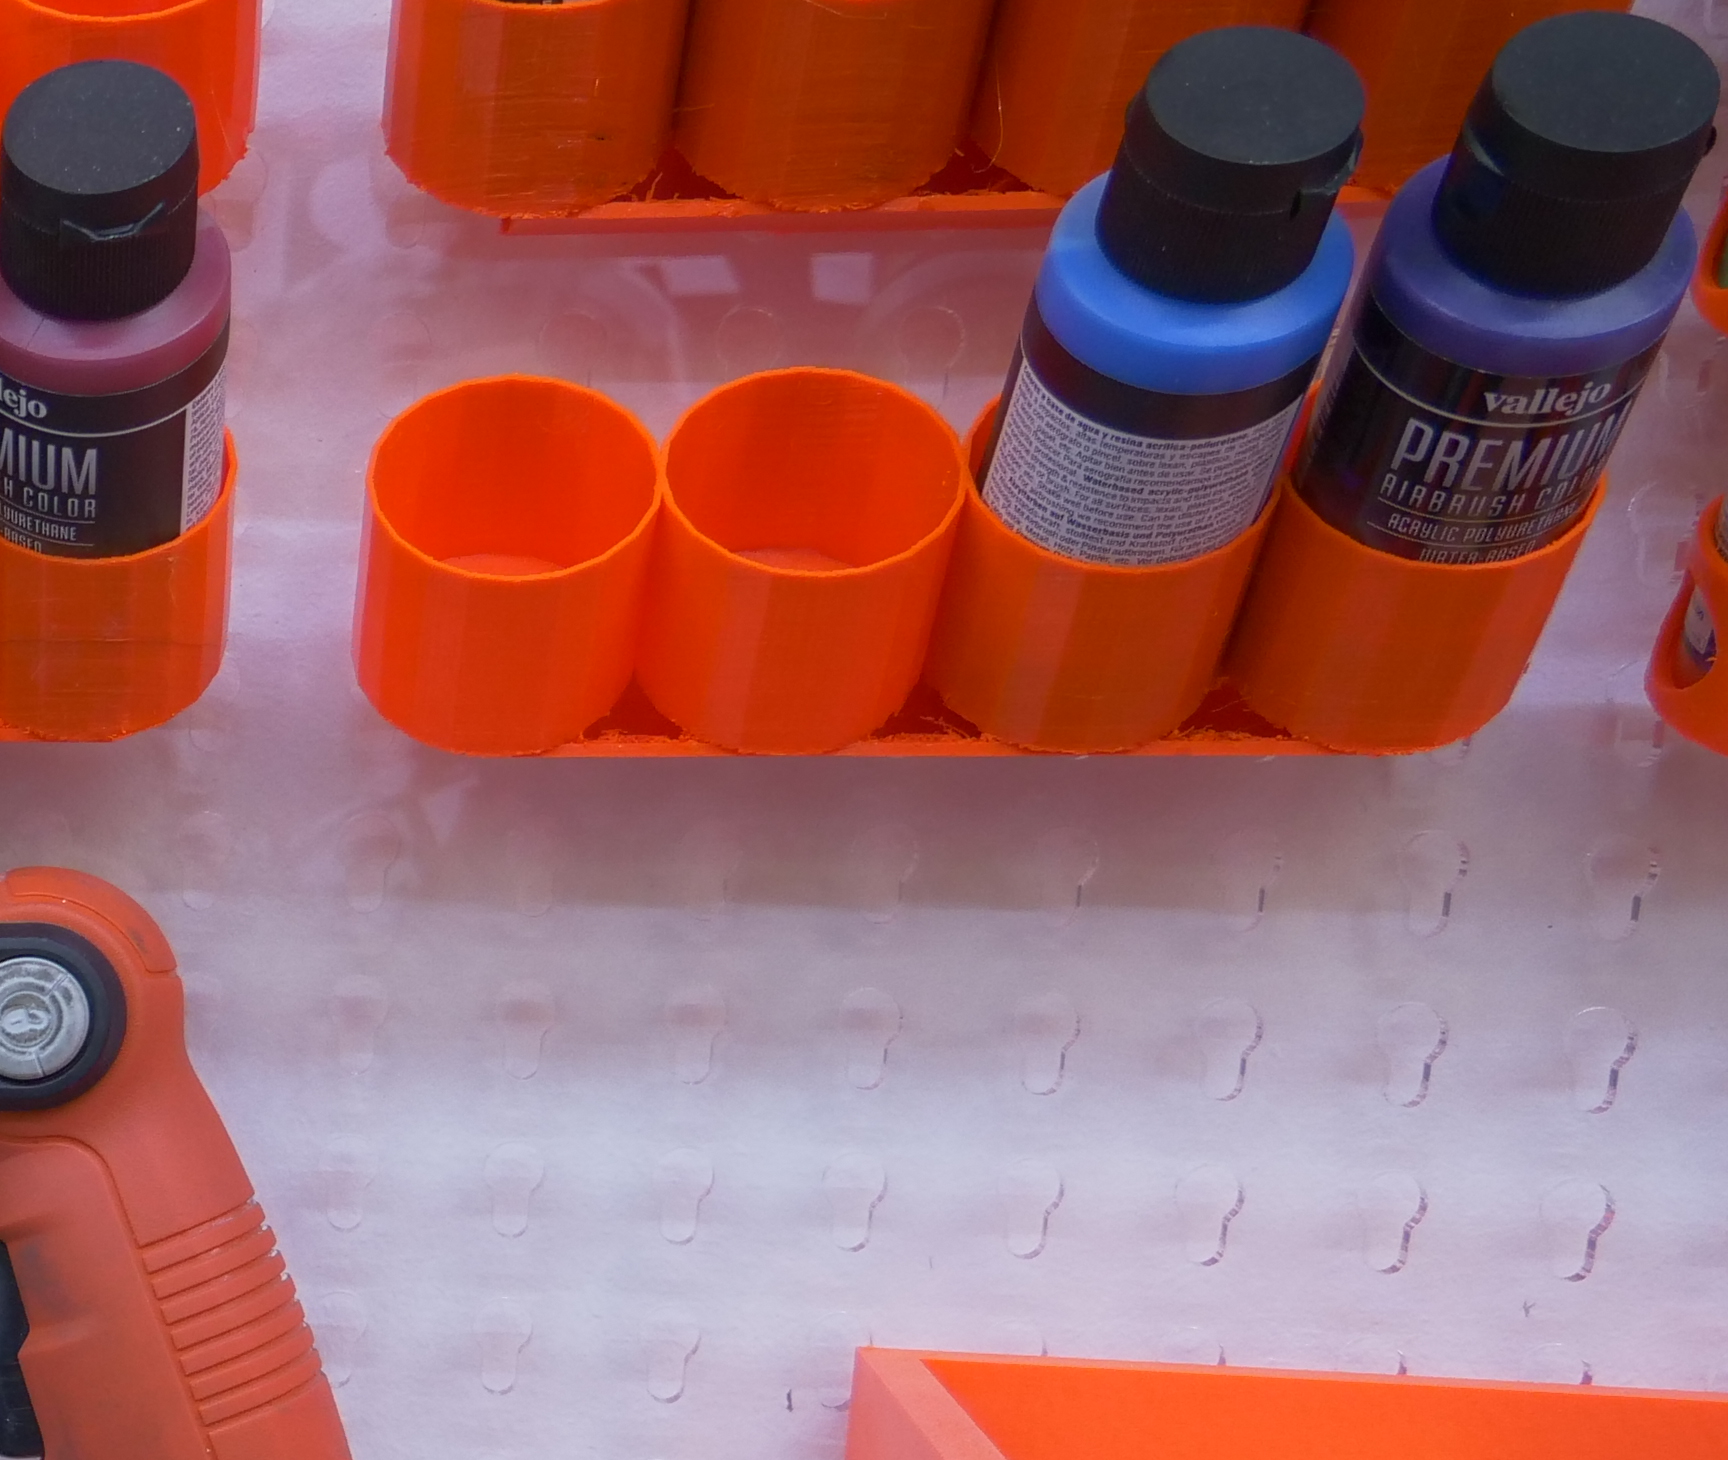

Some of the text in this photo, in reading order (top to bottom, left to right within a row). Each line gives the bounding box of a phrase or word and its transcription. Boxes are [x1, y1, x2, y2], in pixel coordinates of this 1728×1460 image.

[1483, 382, 1611, 416] vallejo
[23, 486, 96, 518] COLOR
[1380, 472, 1527, 517] AIRBRUSH
[1388, 503, 1577, 543] ACRYLIC POLYURETHANE
